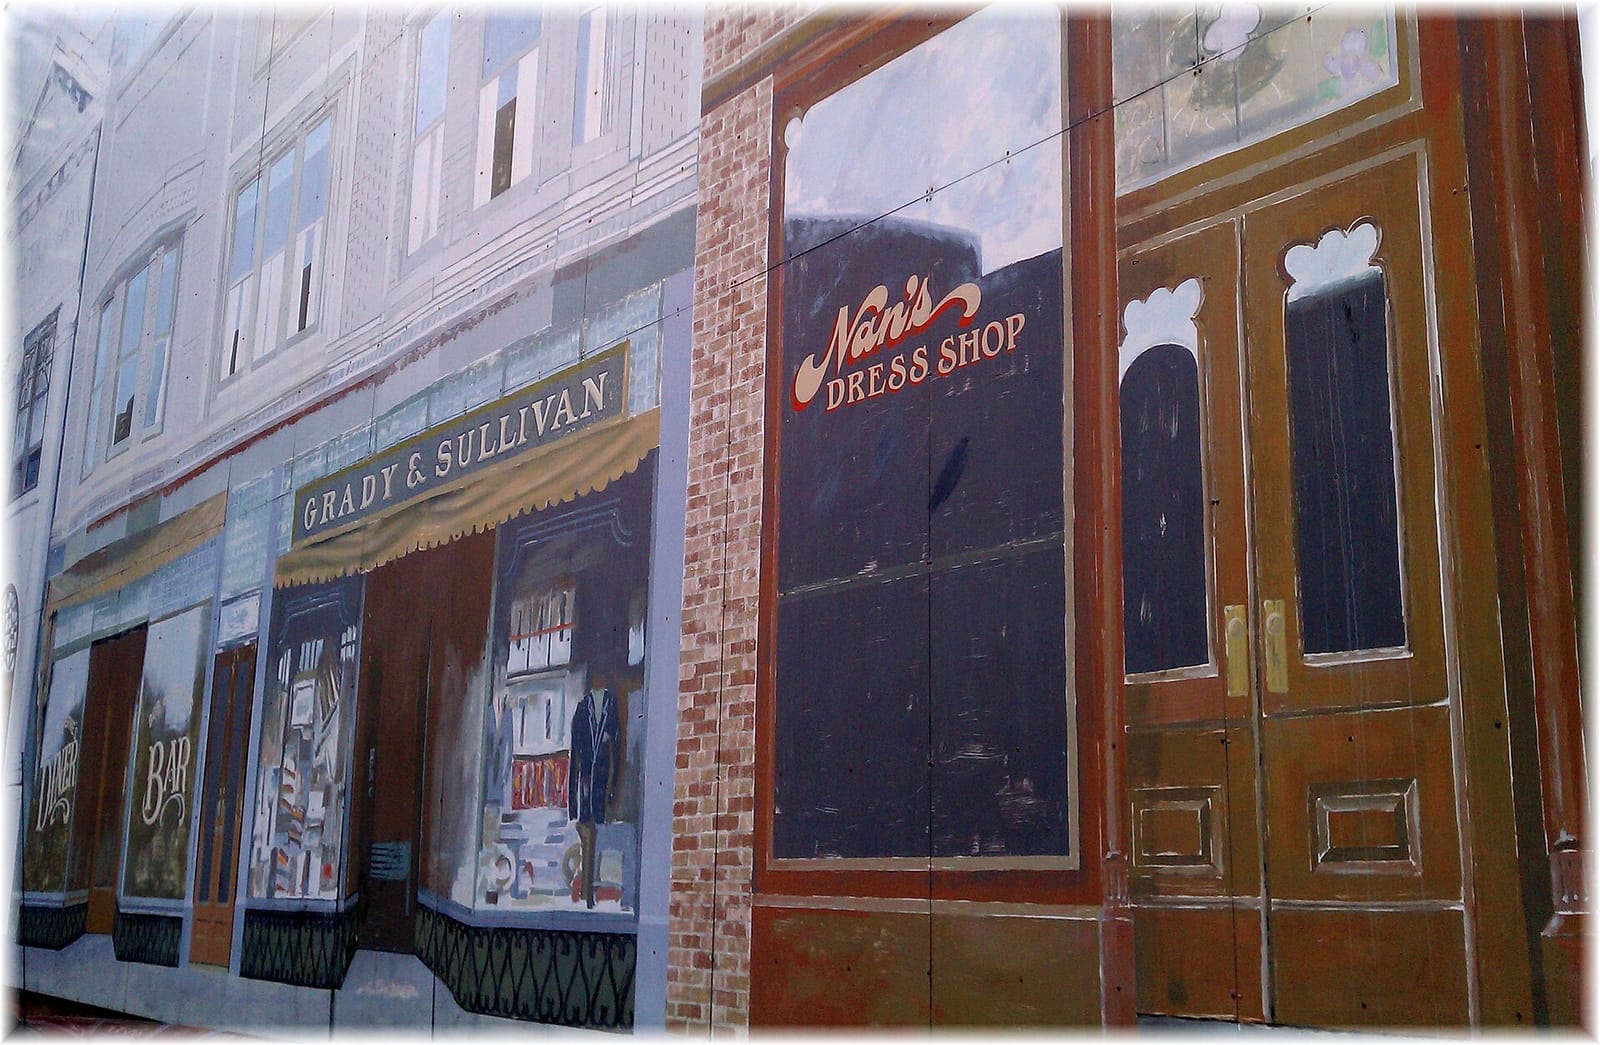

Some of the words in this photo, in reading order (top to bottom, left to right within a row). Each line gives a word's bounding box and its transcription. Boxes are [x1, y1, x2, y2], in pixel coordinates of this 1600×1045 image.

[791, 274, 982, 411] Nan's
[825, 345, 930, 413] DRESS
[936, 312, 1026, 377] SHOP
[303, 463, 398, 531] GRADY
[406, 451, 427, 488] &
[434, 371, 610, 478] SULLIVAN
[35, 739, 79, 832] DINER
[142, 735, 191, 827] BAR
